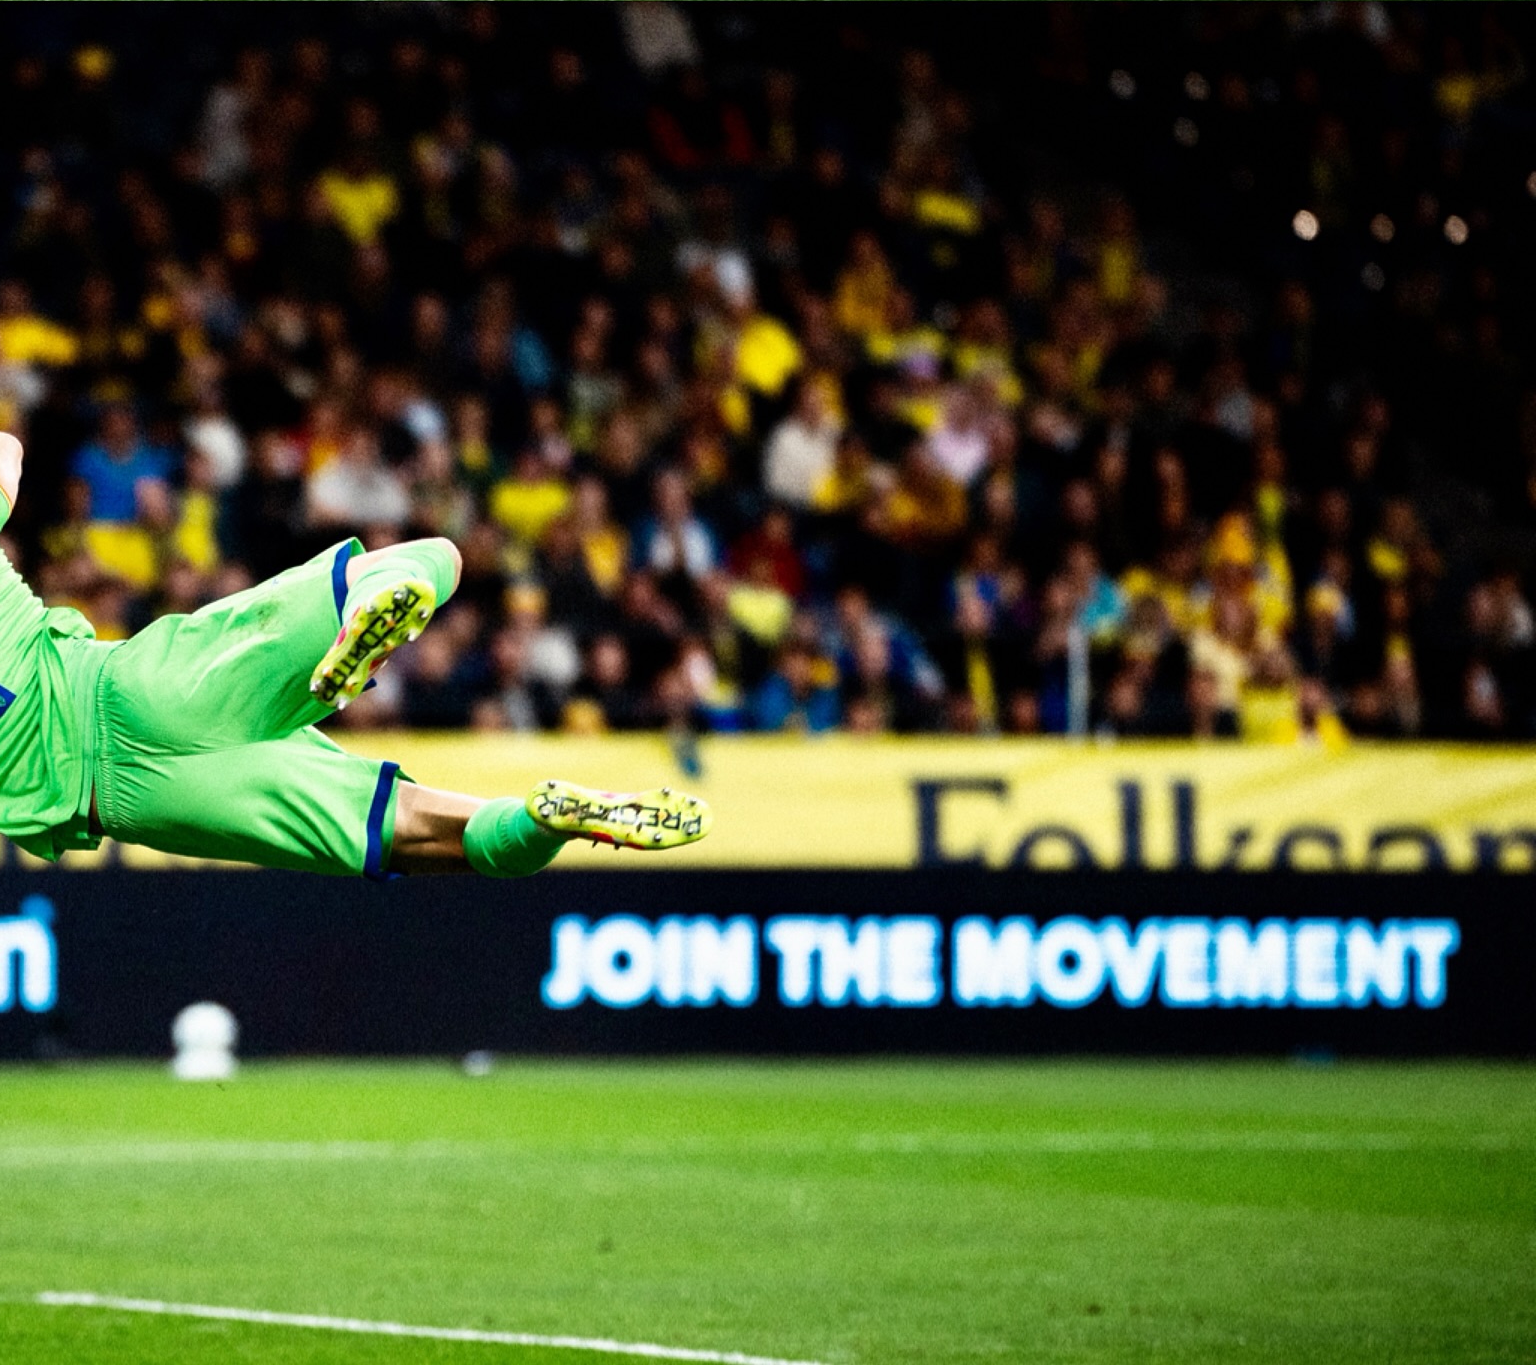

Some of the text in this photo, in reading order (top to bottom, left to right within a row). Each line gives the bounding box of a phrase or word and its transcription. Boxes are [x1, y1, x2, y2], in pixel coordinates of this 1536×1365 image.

[542, 914, 1461, 1010] JOIN THE MOVEMENT
